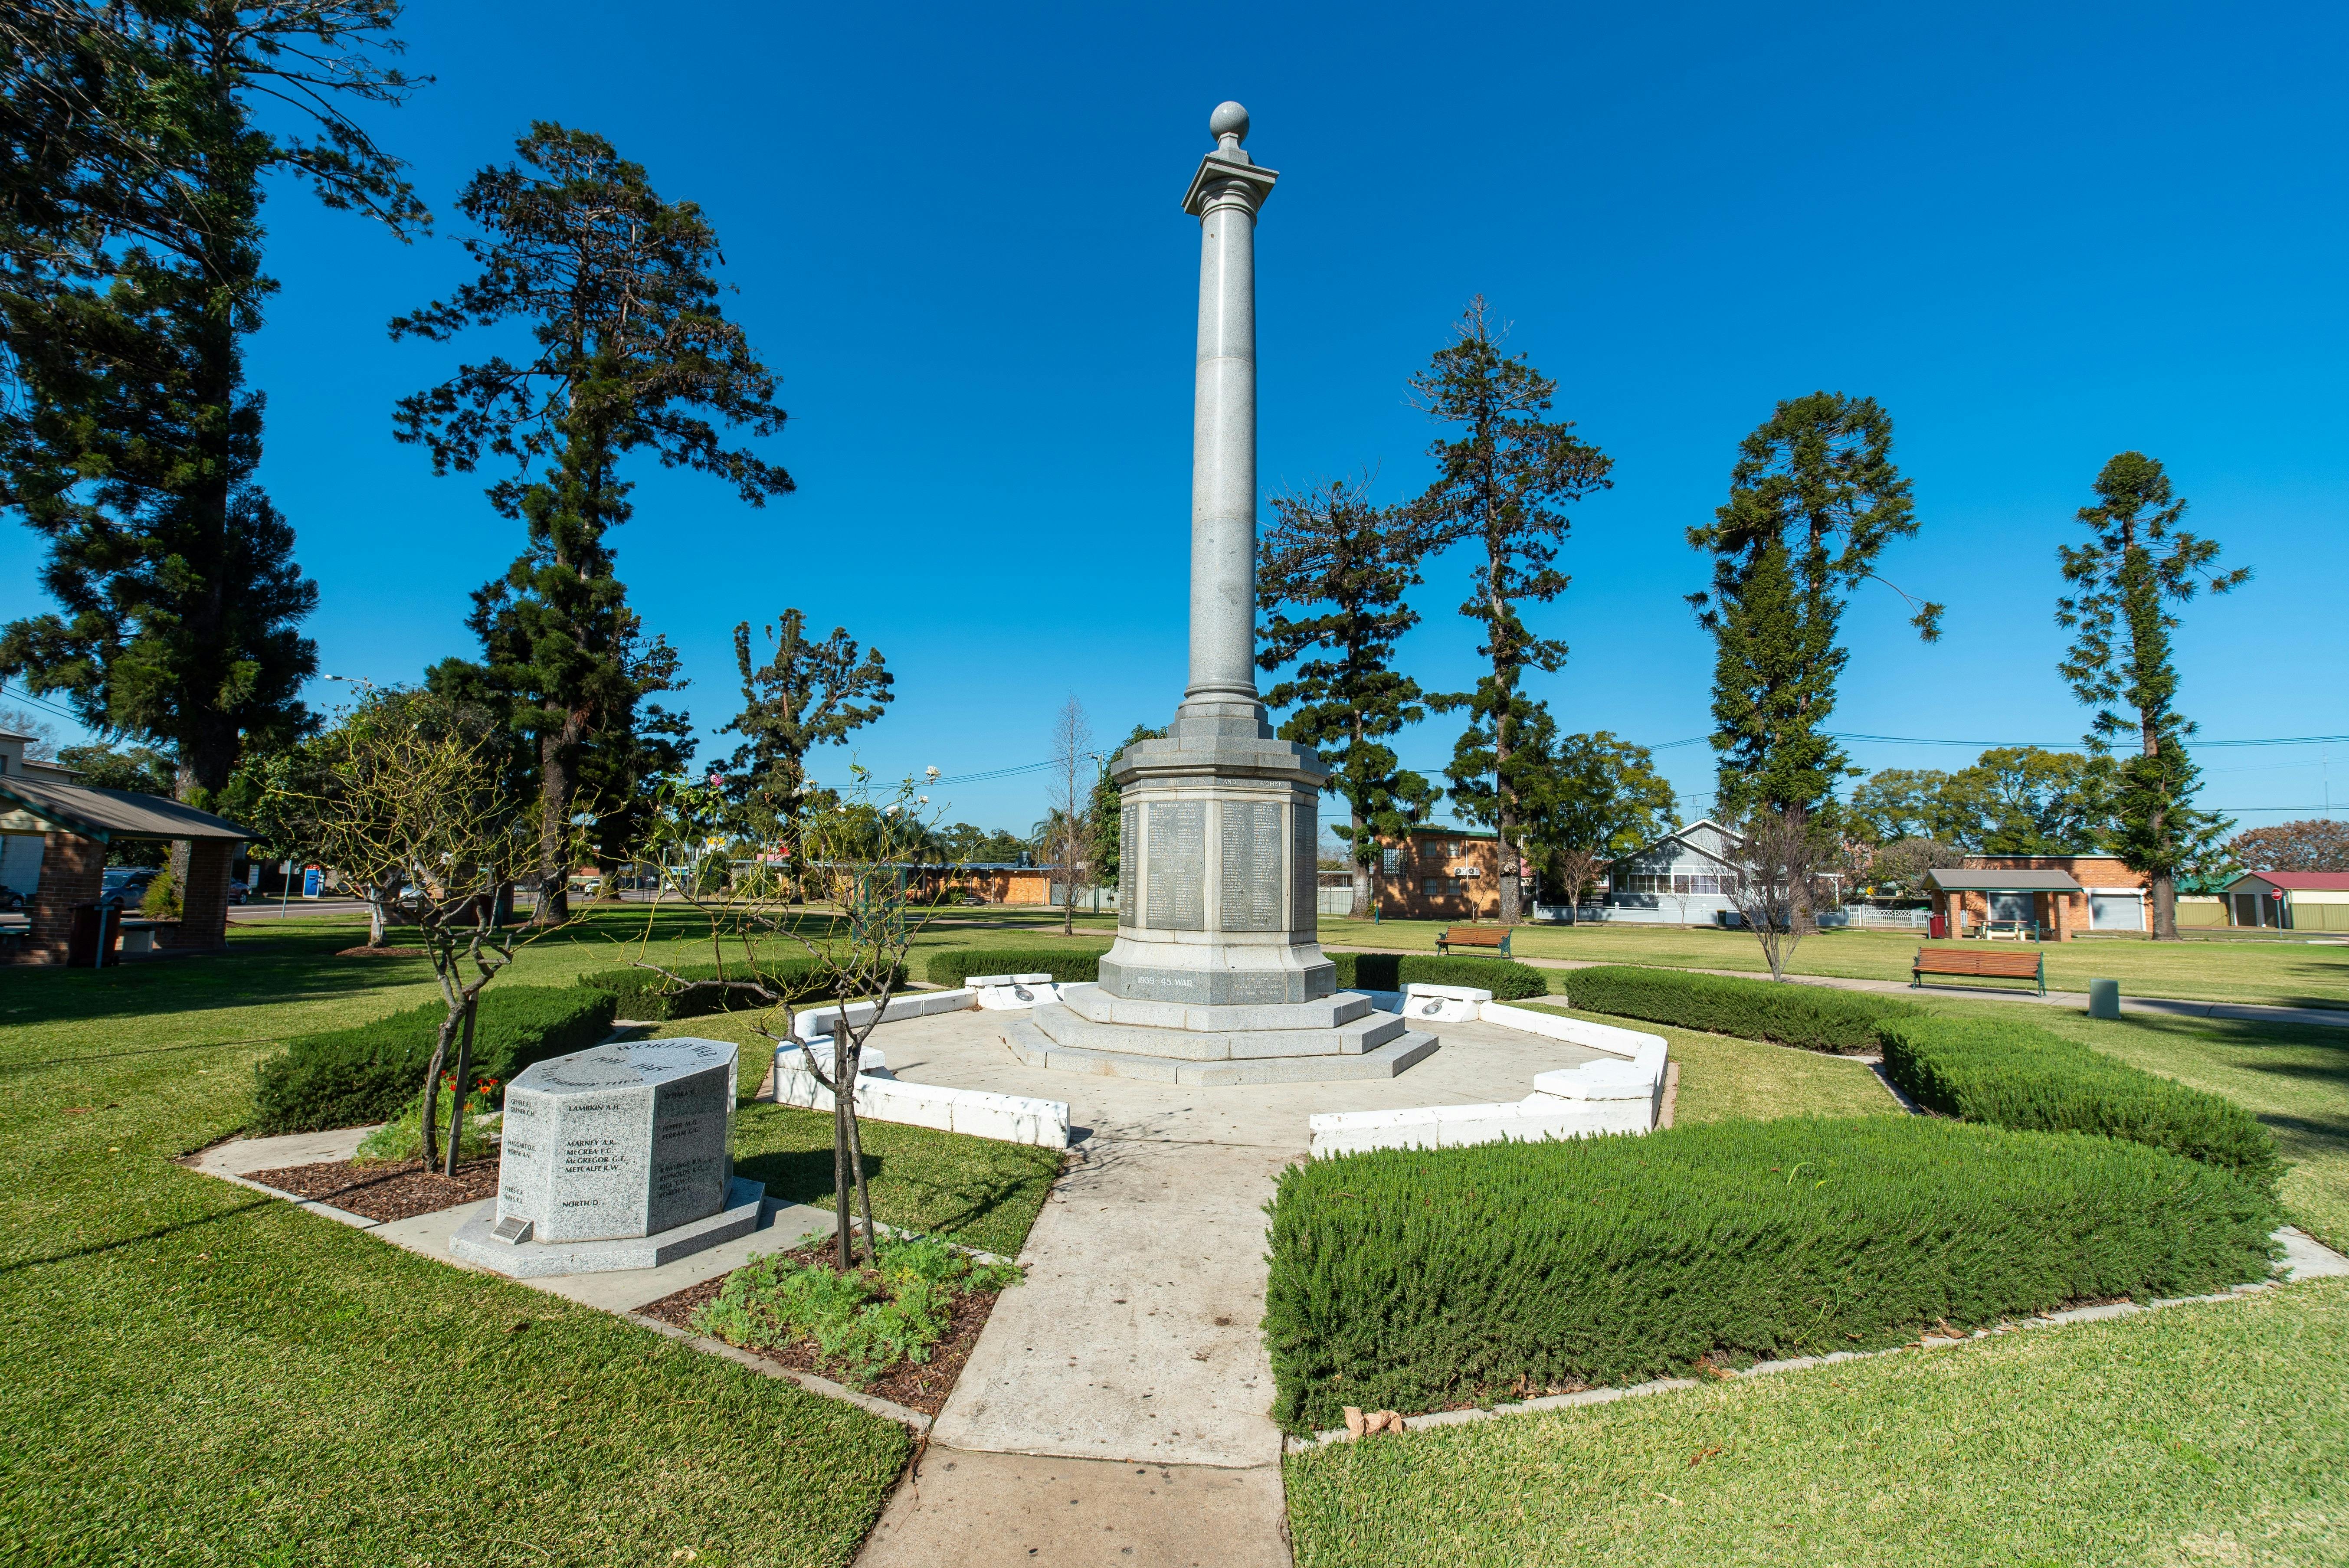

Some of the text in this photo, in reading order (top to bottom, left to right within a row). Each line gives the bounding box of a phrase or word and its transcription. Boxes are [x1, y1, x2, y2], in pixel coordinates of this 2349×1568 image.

[1175, 978, 1193, 987] WAR
[690, 1046, 717, 1057] WAR
[511, 1107, 525, 1115] GERNER
[663, 1123, 682, 1133] PEPPER
[662, 1130, 686, 1140] PERRAM
[508, 1140, 527, 1149] HAGGART
[660, 1161, 690, 1174] RAWLINGS
[659, 1169, 690, 1182] REYNOLDS
[659, 1182, 672, 1190] RICE
[659, 1188, 680, 1199] ROACH
